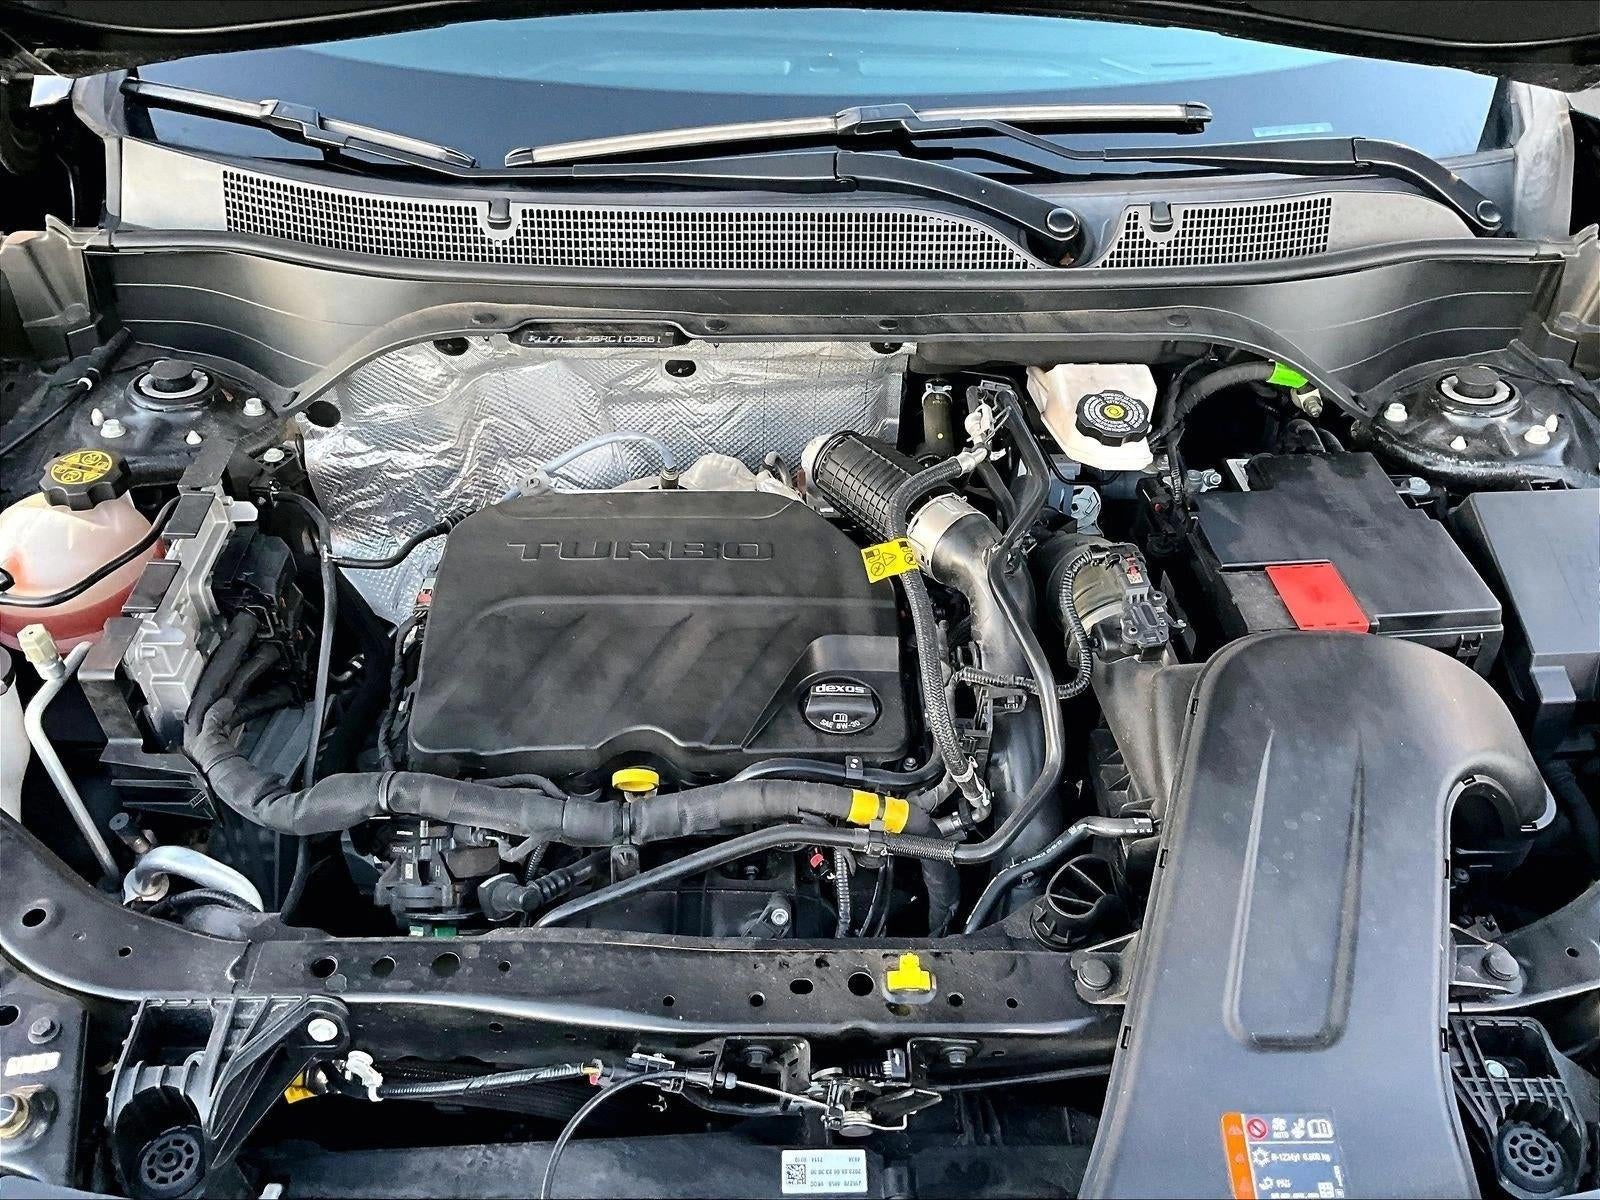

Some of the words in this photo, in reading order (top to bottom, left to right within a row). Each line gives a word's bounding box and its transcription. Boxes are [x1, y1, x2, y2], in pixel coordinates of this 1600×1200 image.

[506, 540, 775, 562] TURBO
[815, 683, 867, 694] dexos
[820, 718, 835, 729] SAE
[836, 719, 861, 730] 5W-30
